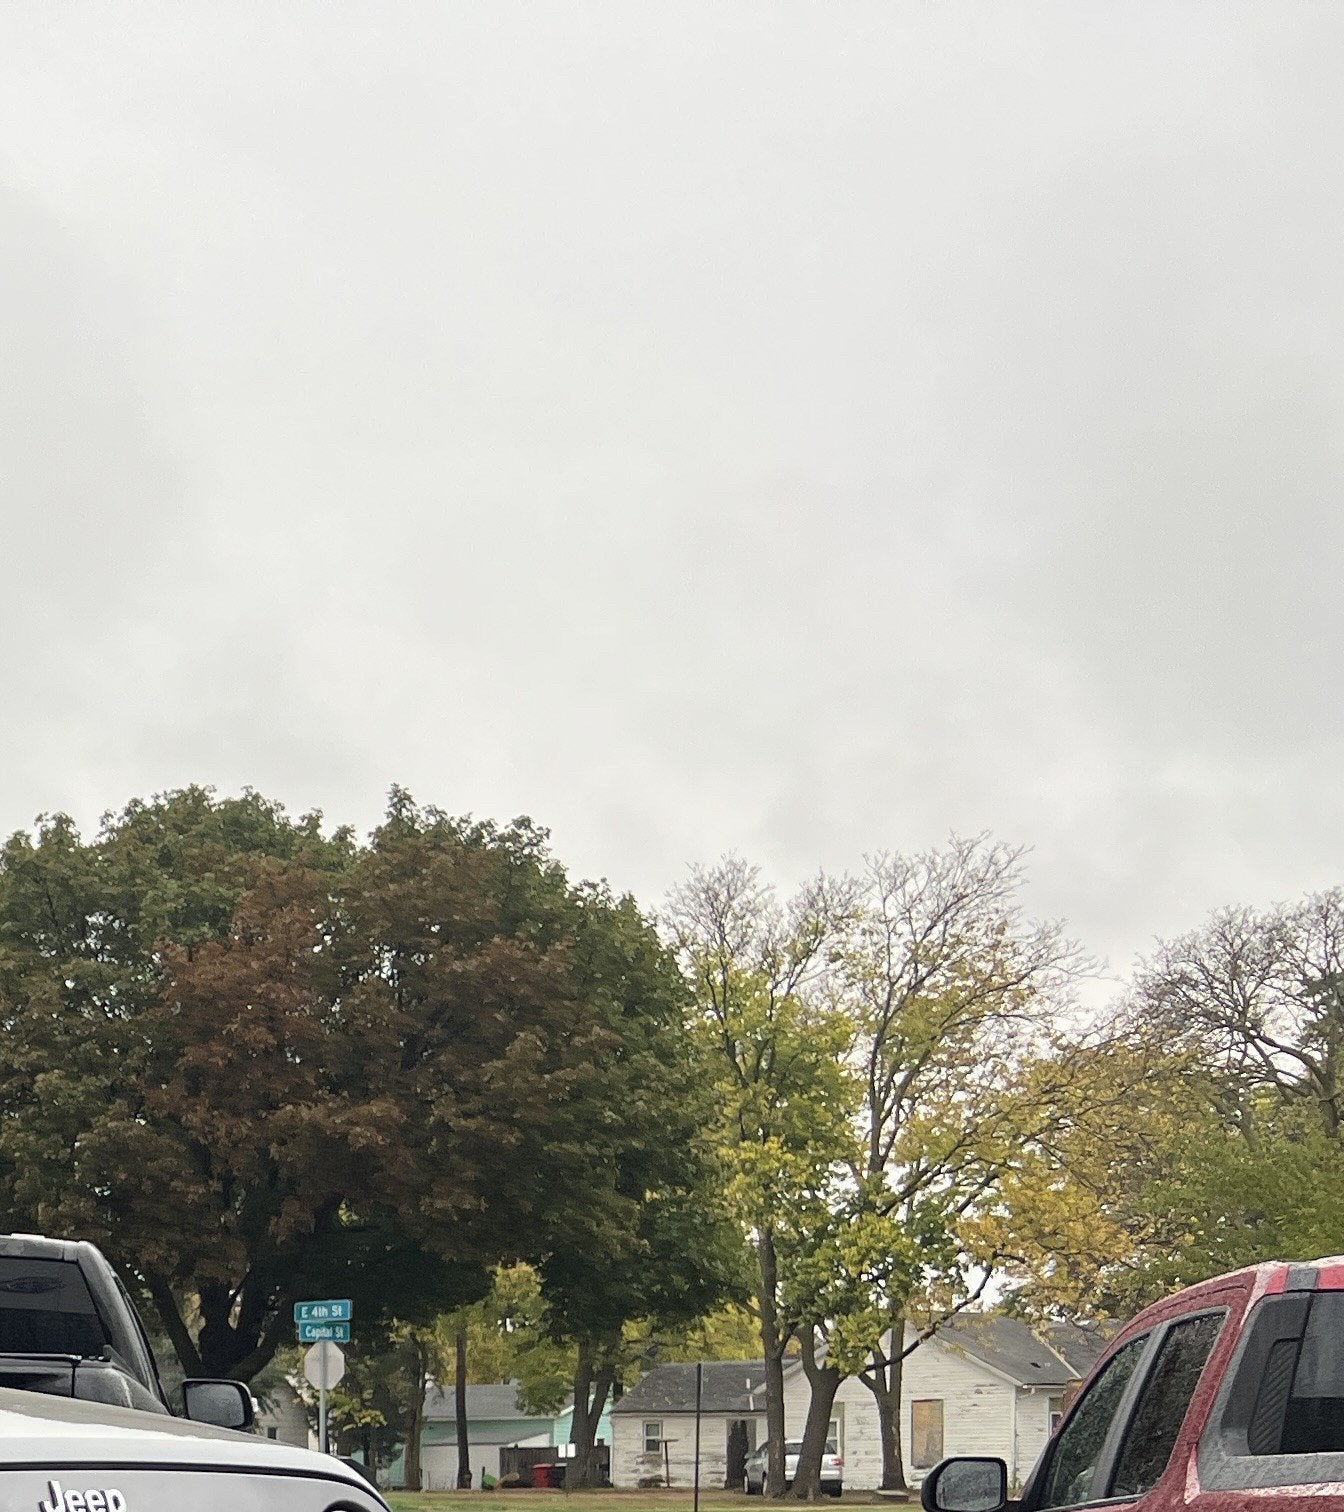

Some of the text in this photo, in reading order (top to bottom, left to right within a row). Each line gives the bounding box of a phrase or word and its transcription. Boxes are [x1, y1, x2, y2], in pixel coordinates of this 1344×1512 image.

[301, 1305, 343, 1319] E 4th St
[335, 1326, 344, 1339] St
